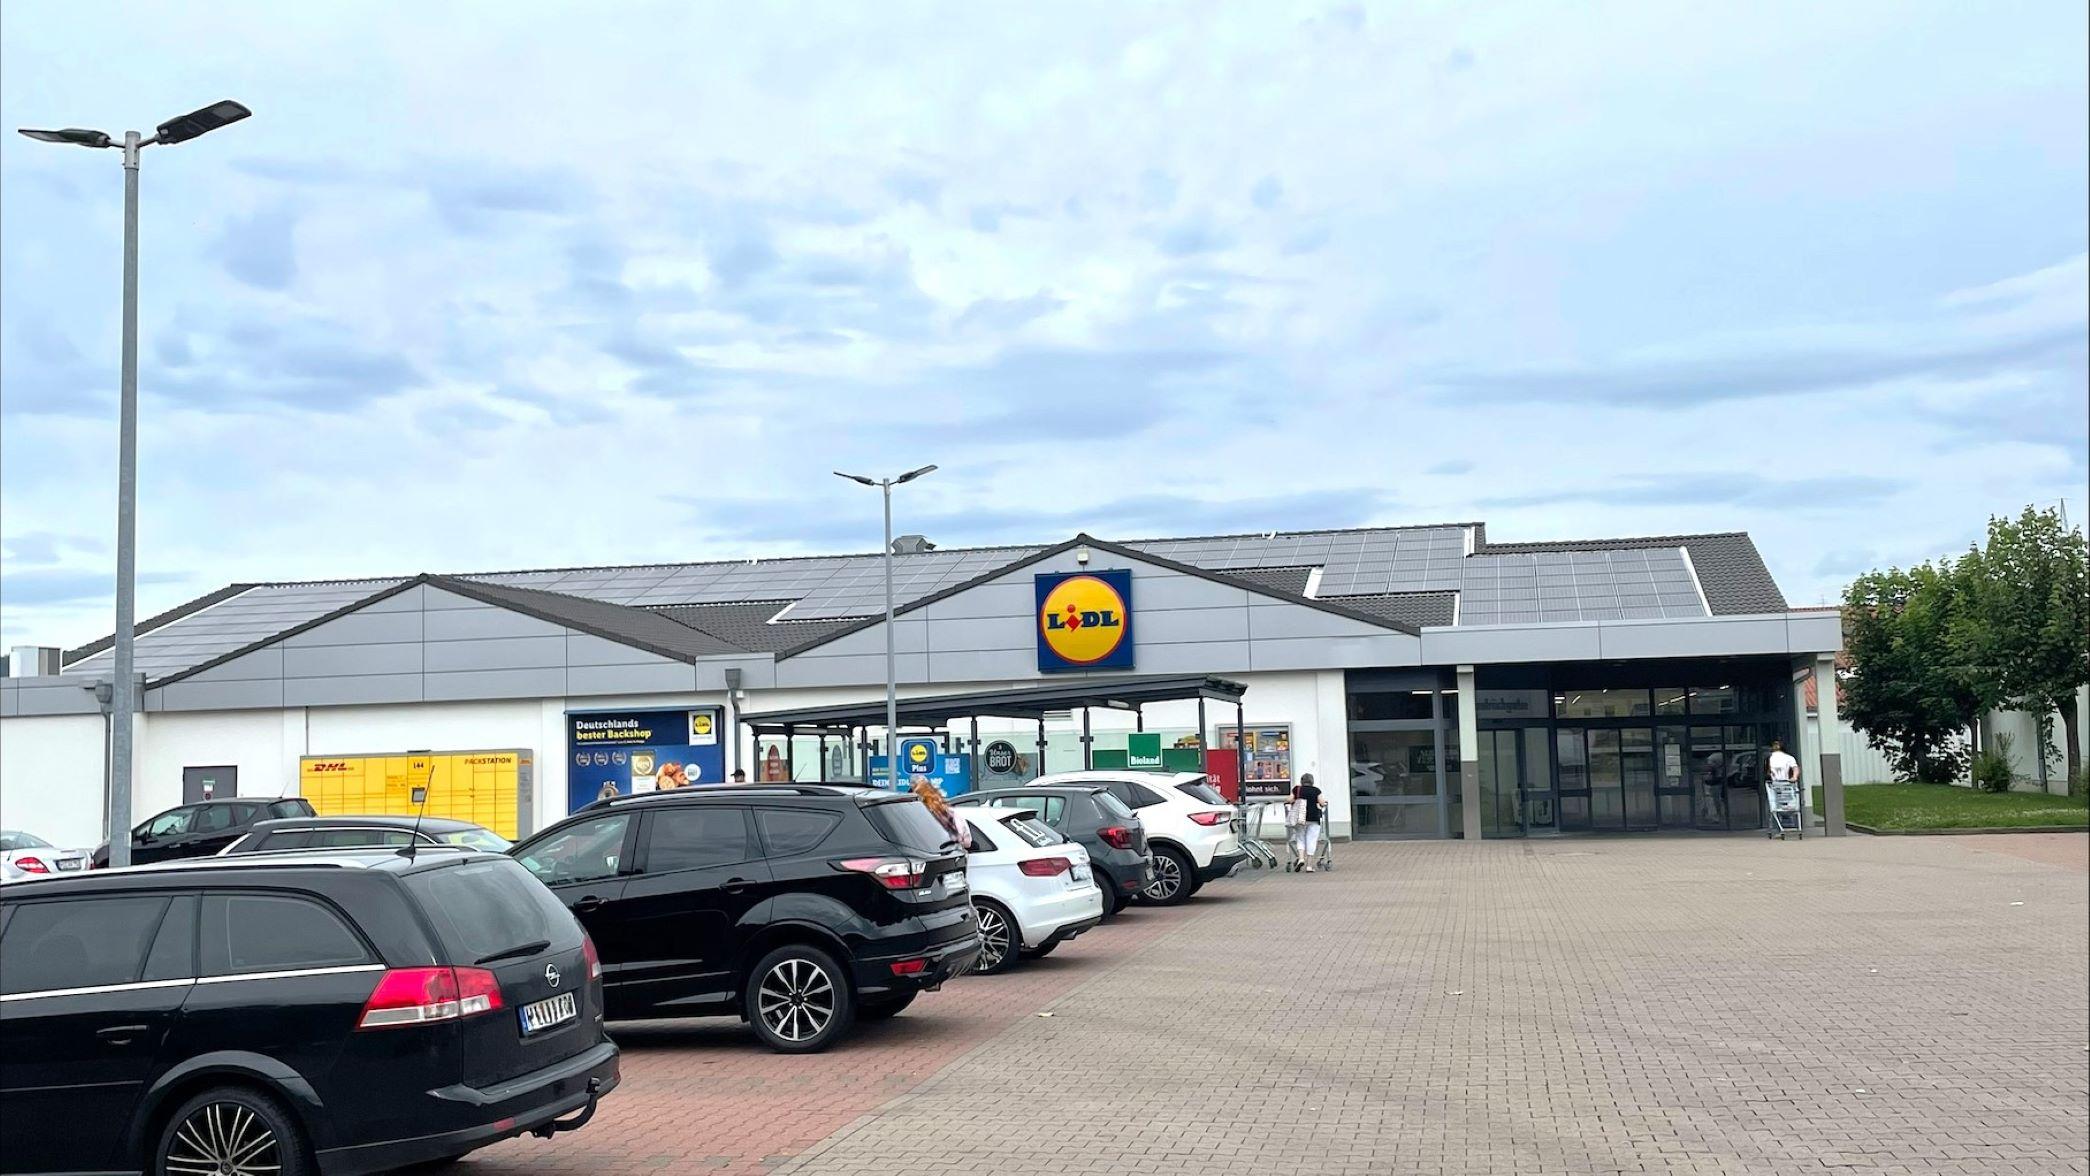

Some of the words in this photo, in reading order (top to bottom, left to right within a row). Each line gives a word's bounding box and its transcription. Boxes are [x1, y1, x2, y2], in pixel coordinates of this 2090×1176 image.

[576, 719, 639, 730] Deutschlands
[576, 731, 606, 740] bester
[607, 729, 652, 740] Backshop
[464, 757, 512, 765] PACKSTATION
[989, 755, 1012, 767] BROT
[1130, 755, 1160, 765] Bioland
[314, 763, 347, 772] DHL
[911, 764, 927, 772] Plus
